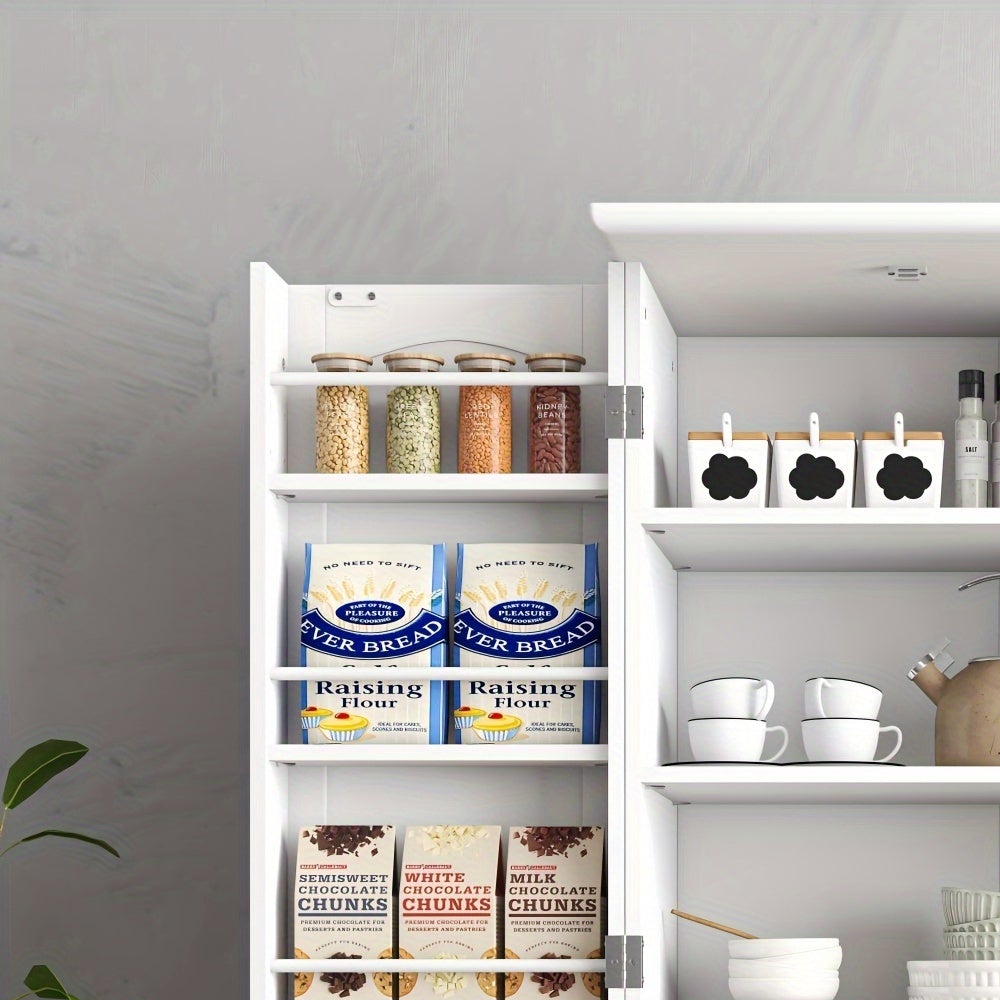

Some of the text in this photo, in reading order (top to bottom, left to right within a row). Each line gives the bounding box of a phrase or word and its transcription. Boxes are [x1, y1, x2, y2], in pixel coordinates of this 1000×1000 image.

[323, 563, 339, 571] NO
[395, 562, 422, 571] SIFT
[475, 563, 491, 571] NO
[548, 562, 574, 571] SIFT
[362, 620, 442, 653] BREAD
[516, 620, 595, 653] BREAD
[315, 680, 423, 699] Raising
[468, 680, 576, 699] Raising
[341, 697, 398, 708] Flour
[494, 697, 551, 708] Flour
[299, 874, 388, 883] SEMISWEET
[404, 872, 465, 883] WHITE
[510, 874, 556, 883] MILK
[299, 886, 388, 895] CHOCOLATE
[403, 886, 491, 895] CHOCOLATE
[509, 887, 597, 895] CHOCOLATE
[298, 898, 388, 911] CHUNKS
[402, 898, 491, 911] CHUNKS
[508, 899, 597, 912] CHUNKS
